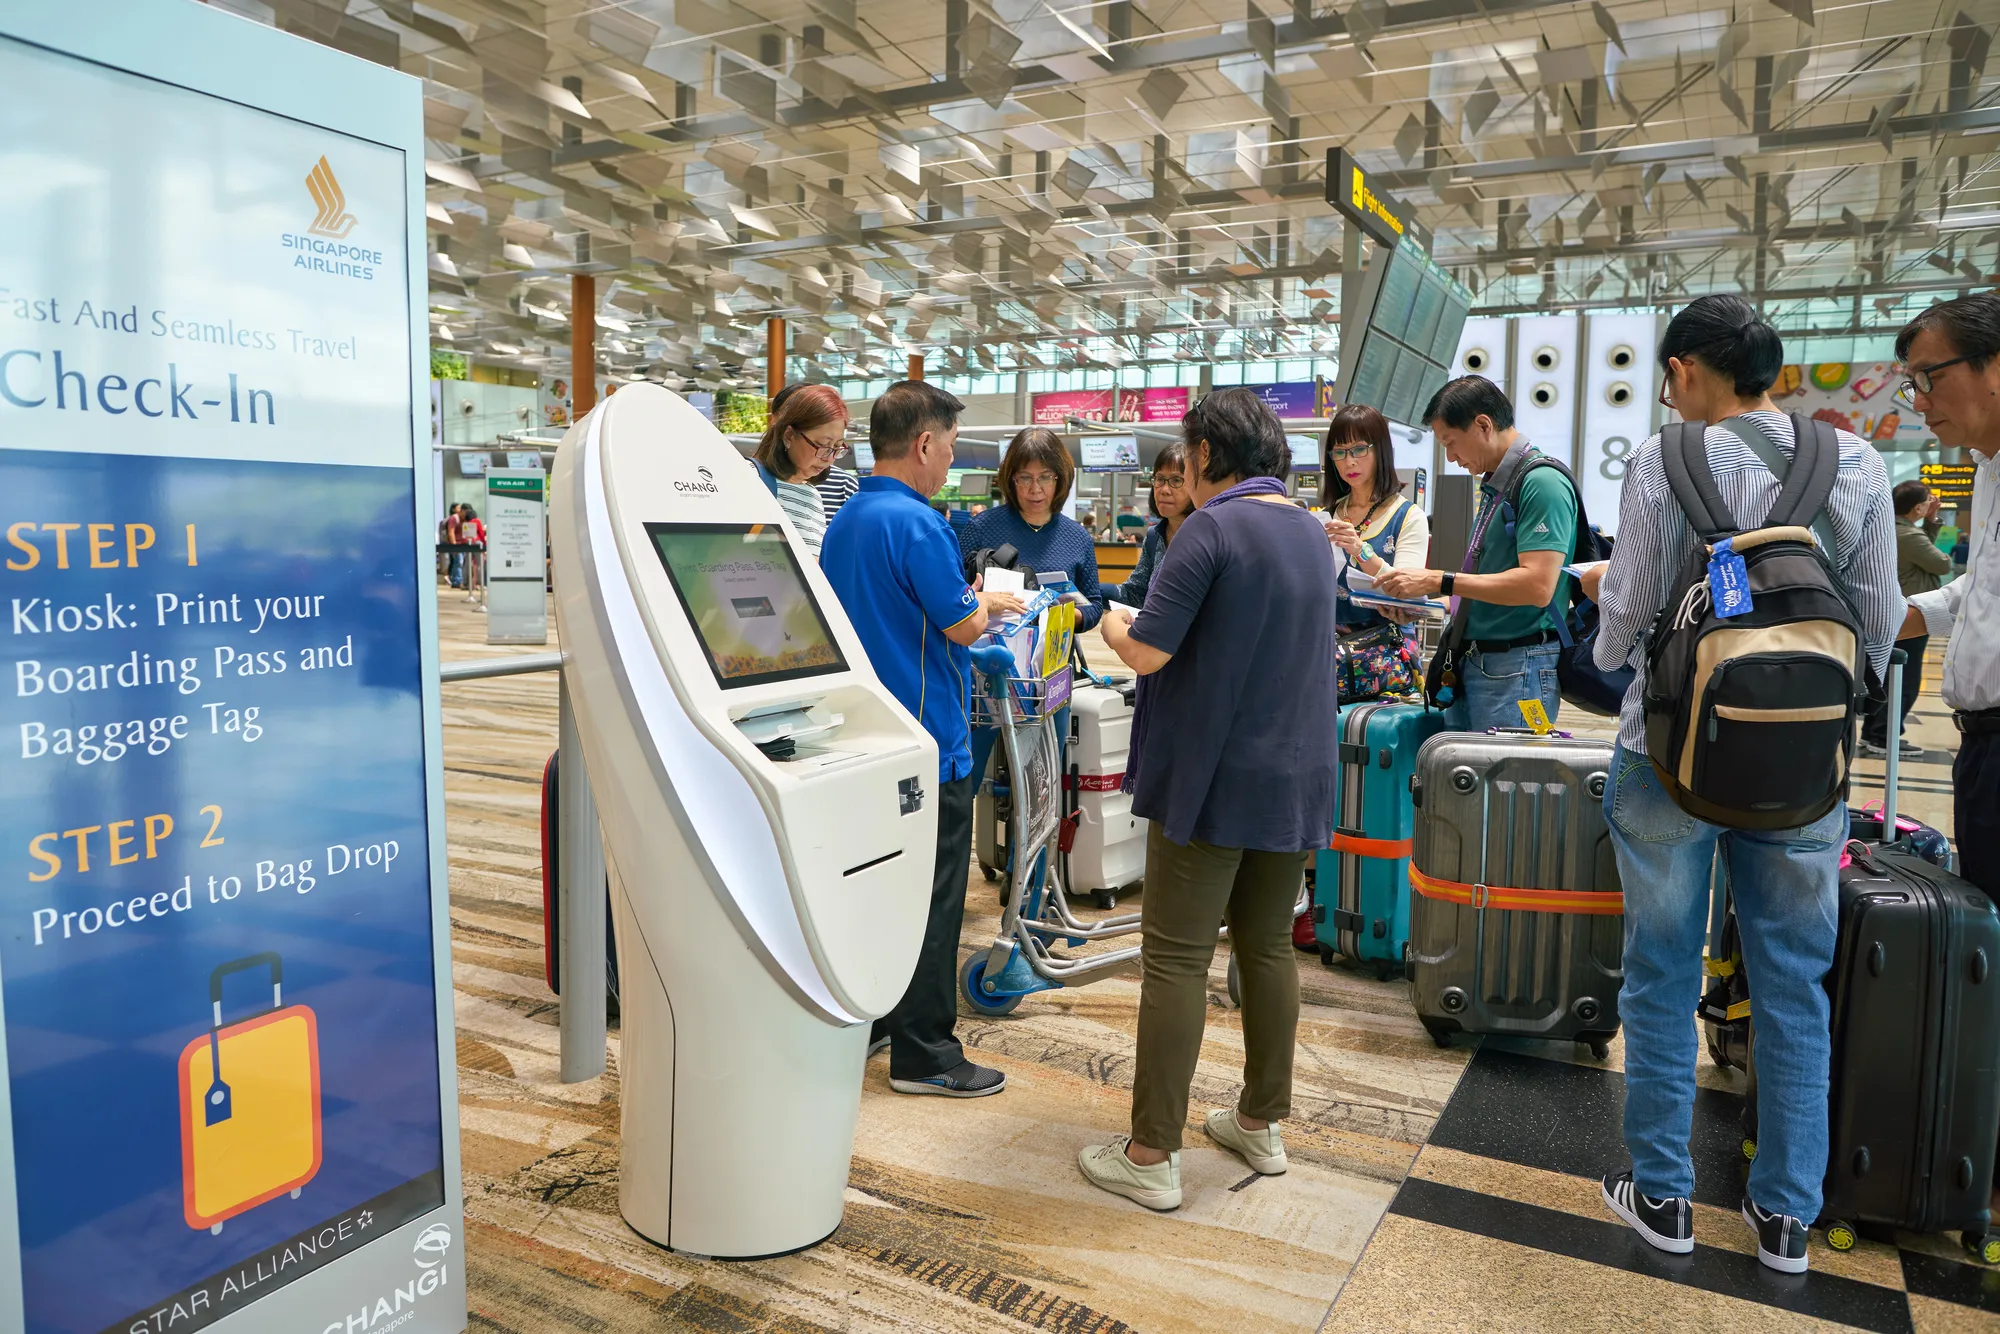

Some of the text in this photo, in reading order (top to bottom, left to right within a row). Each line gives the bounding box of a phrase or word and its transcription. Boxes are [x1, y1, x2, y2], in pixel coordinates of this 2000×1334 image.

[1363, 187, 1378, 213] Flight
[1377, 200, 1404, 235] Information
[281, 233, 382, 265] SINGAPORE
[293, 254, 374, 280] AIRLINES
[73, 300, 138, 333] And
[151, 310, 277, 351] Seamless
[286, 329, 357, 360] Travel
[0, 349, 275, 425] Check-In
[1599, 436, 1632, 481] 8
[674, 481, 719, 493] CHANGI
[6, 522, 198, 571] STEP 1
[698, 562, 735, 574] Boarding
[755, 561, 772, 573] Bag
[771, 560, 787, 572] Tag
[12, 593, 325, 635] Kiosk: Print your
[16, 635, 354, 697] Boarding Pass and
[20, 701, 263, 765] Baggage Tag
[28, 804, 225, 882] STEP 2
[32, 839, 399, 945] Proceed to Bag Drop
[129, 1217, 353, 1334] STAR ALLIANCE
